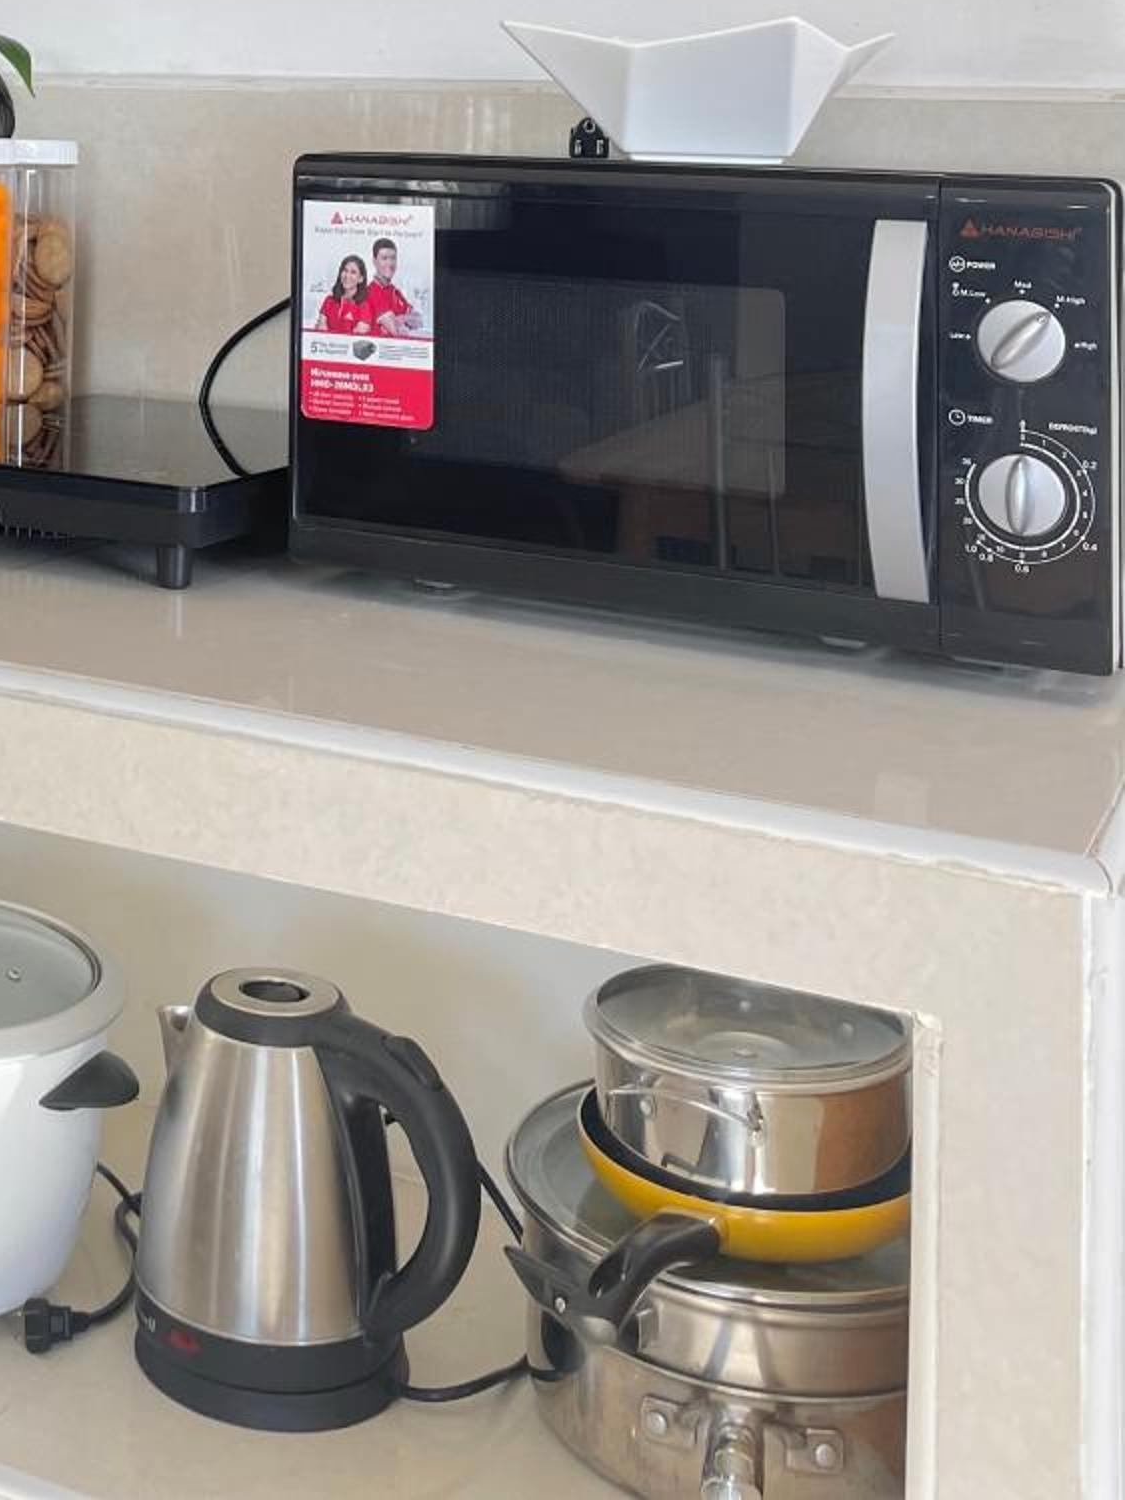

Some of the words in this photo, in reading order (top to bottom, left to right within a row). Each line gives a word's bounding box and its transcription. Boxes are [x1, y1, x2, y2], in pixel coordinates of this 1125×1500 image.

[982, 224, 1076, 240] HANABISHI
[966, 260, 996, 270] POWER
[1014, 280, 1032, 289] Med
[967, 414, 993, 425] TIMER
